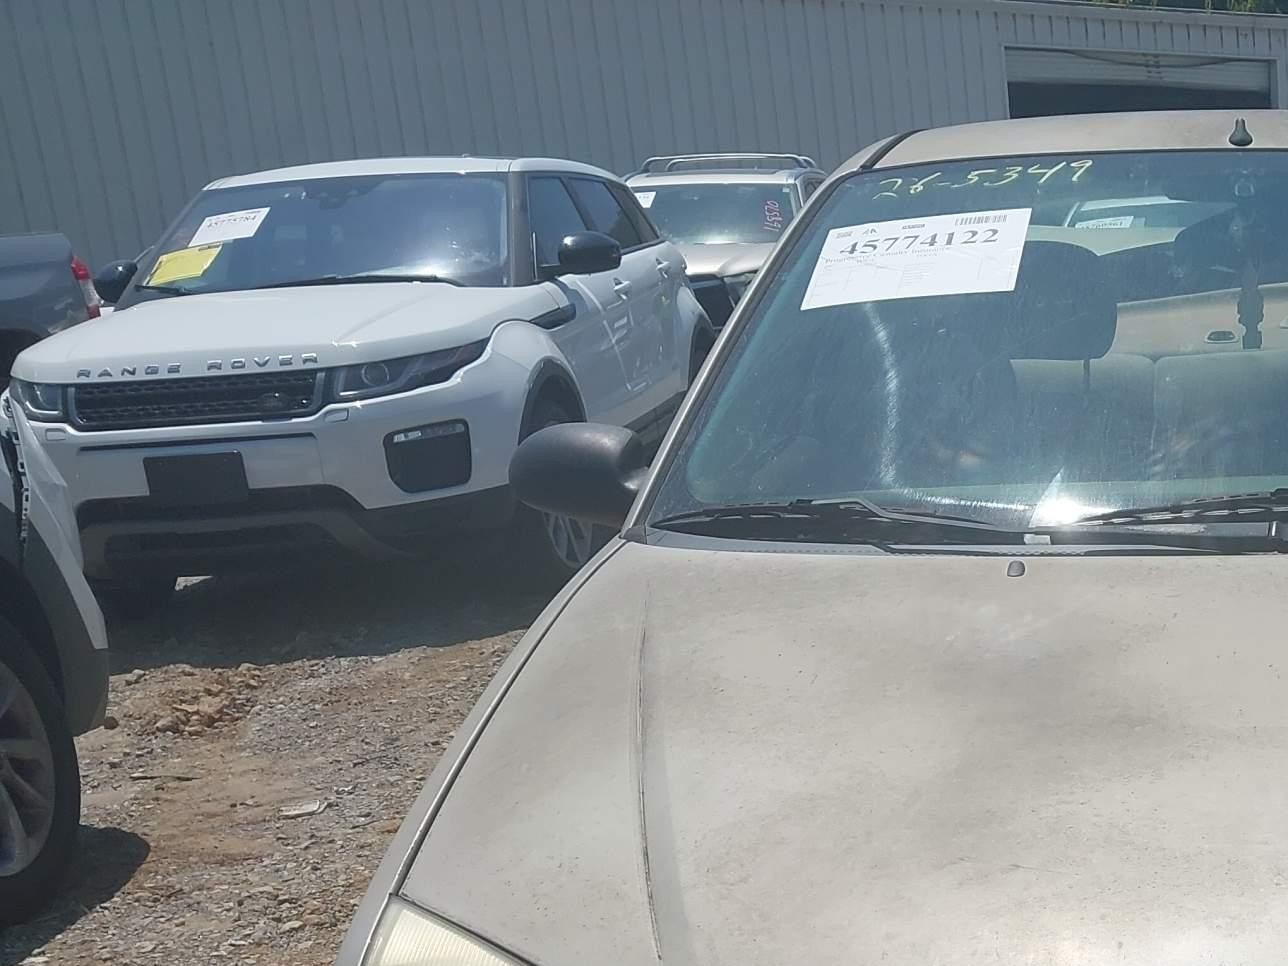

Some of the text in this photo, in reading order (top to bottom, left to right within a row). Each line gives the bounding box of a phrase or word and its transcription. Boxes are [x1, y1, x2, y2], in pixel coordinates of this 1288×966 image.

[839, 228, 1000, 255] 45774122
[77, 353, 318, 379] RANGE ROVER
